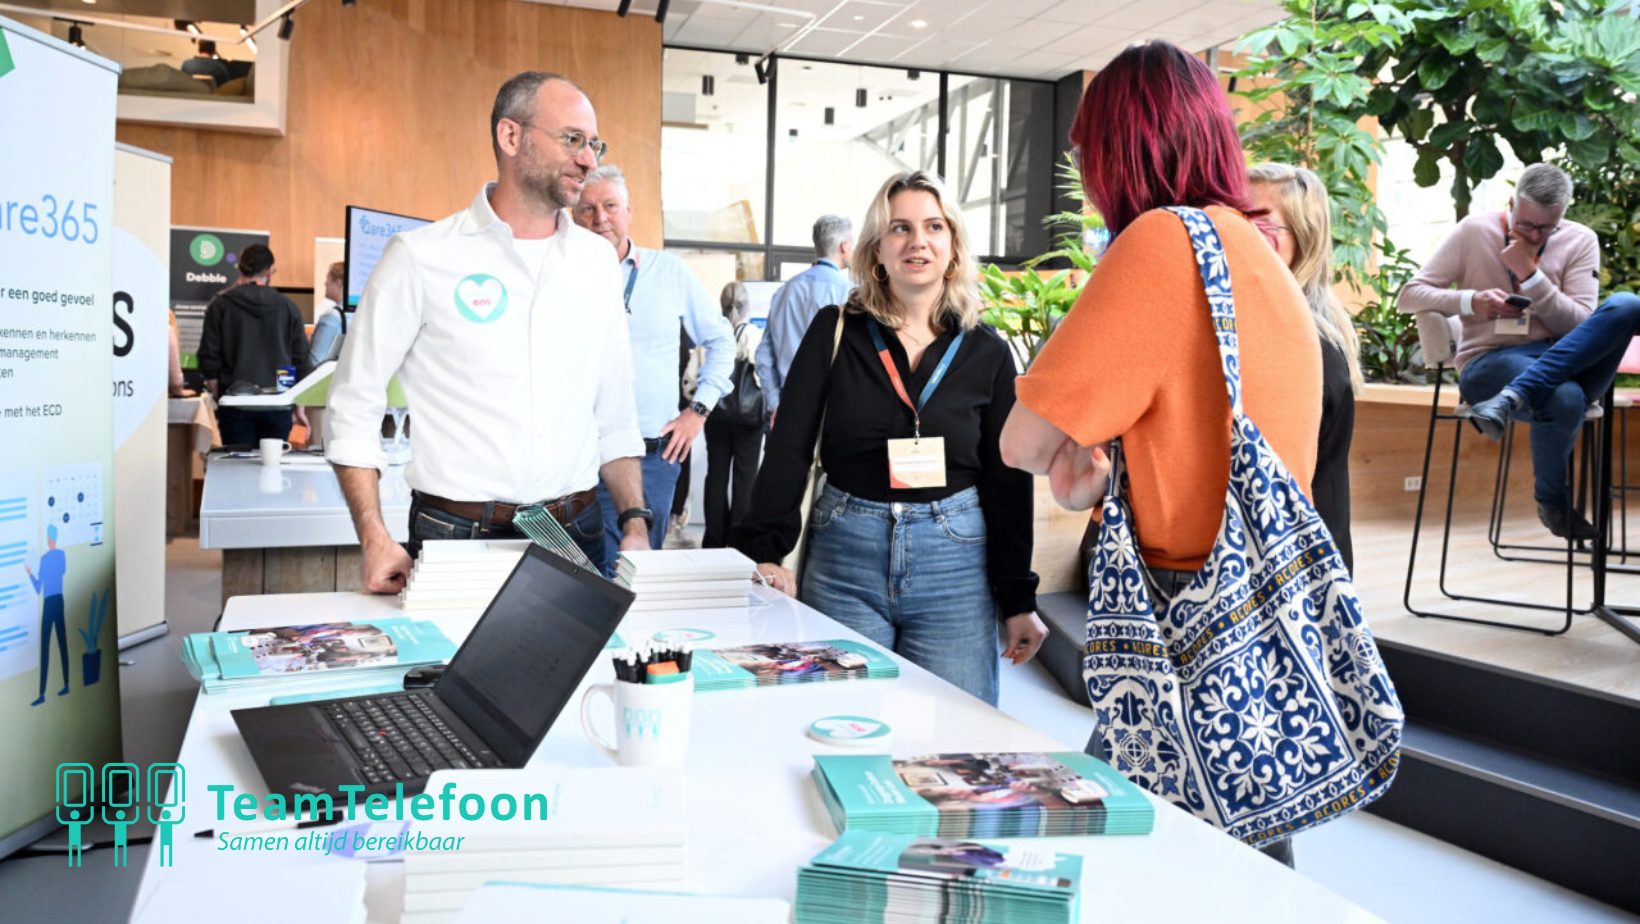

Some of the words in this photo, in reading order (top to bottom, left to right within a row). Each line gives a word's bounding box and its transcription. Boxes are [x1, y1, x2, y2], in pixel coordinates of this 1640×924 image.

[0, 193, 98, 245] re365
[186, 271, 228, 284] Debble
[8, 288, 29, 300] een
[32, 290, 58, 305] goed
[60, 293, 95, 307] gevoel
[35, 329, 47, 340] en
[49, 328, 97, 342] herkennen
[4, 406, 24, 419] met
[25, 405, 41, 418] het
[43, 404, 63, 416] ECD
[1314, 784, 1366, 819] ACORES
